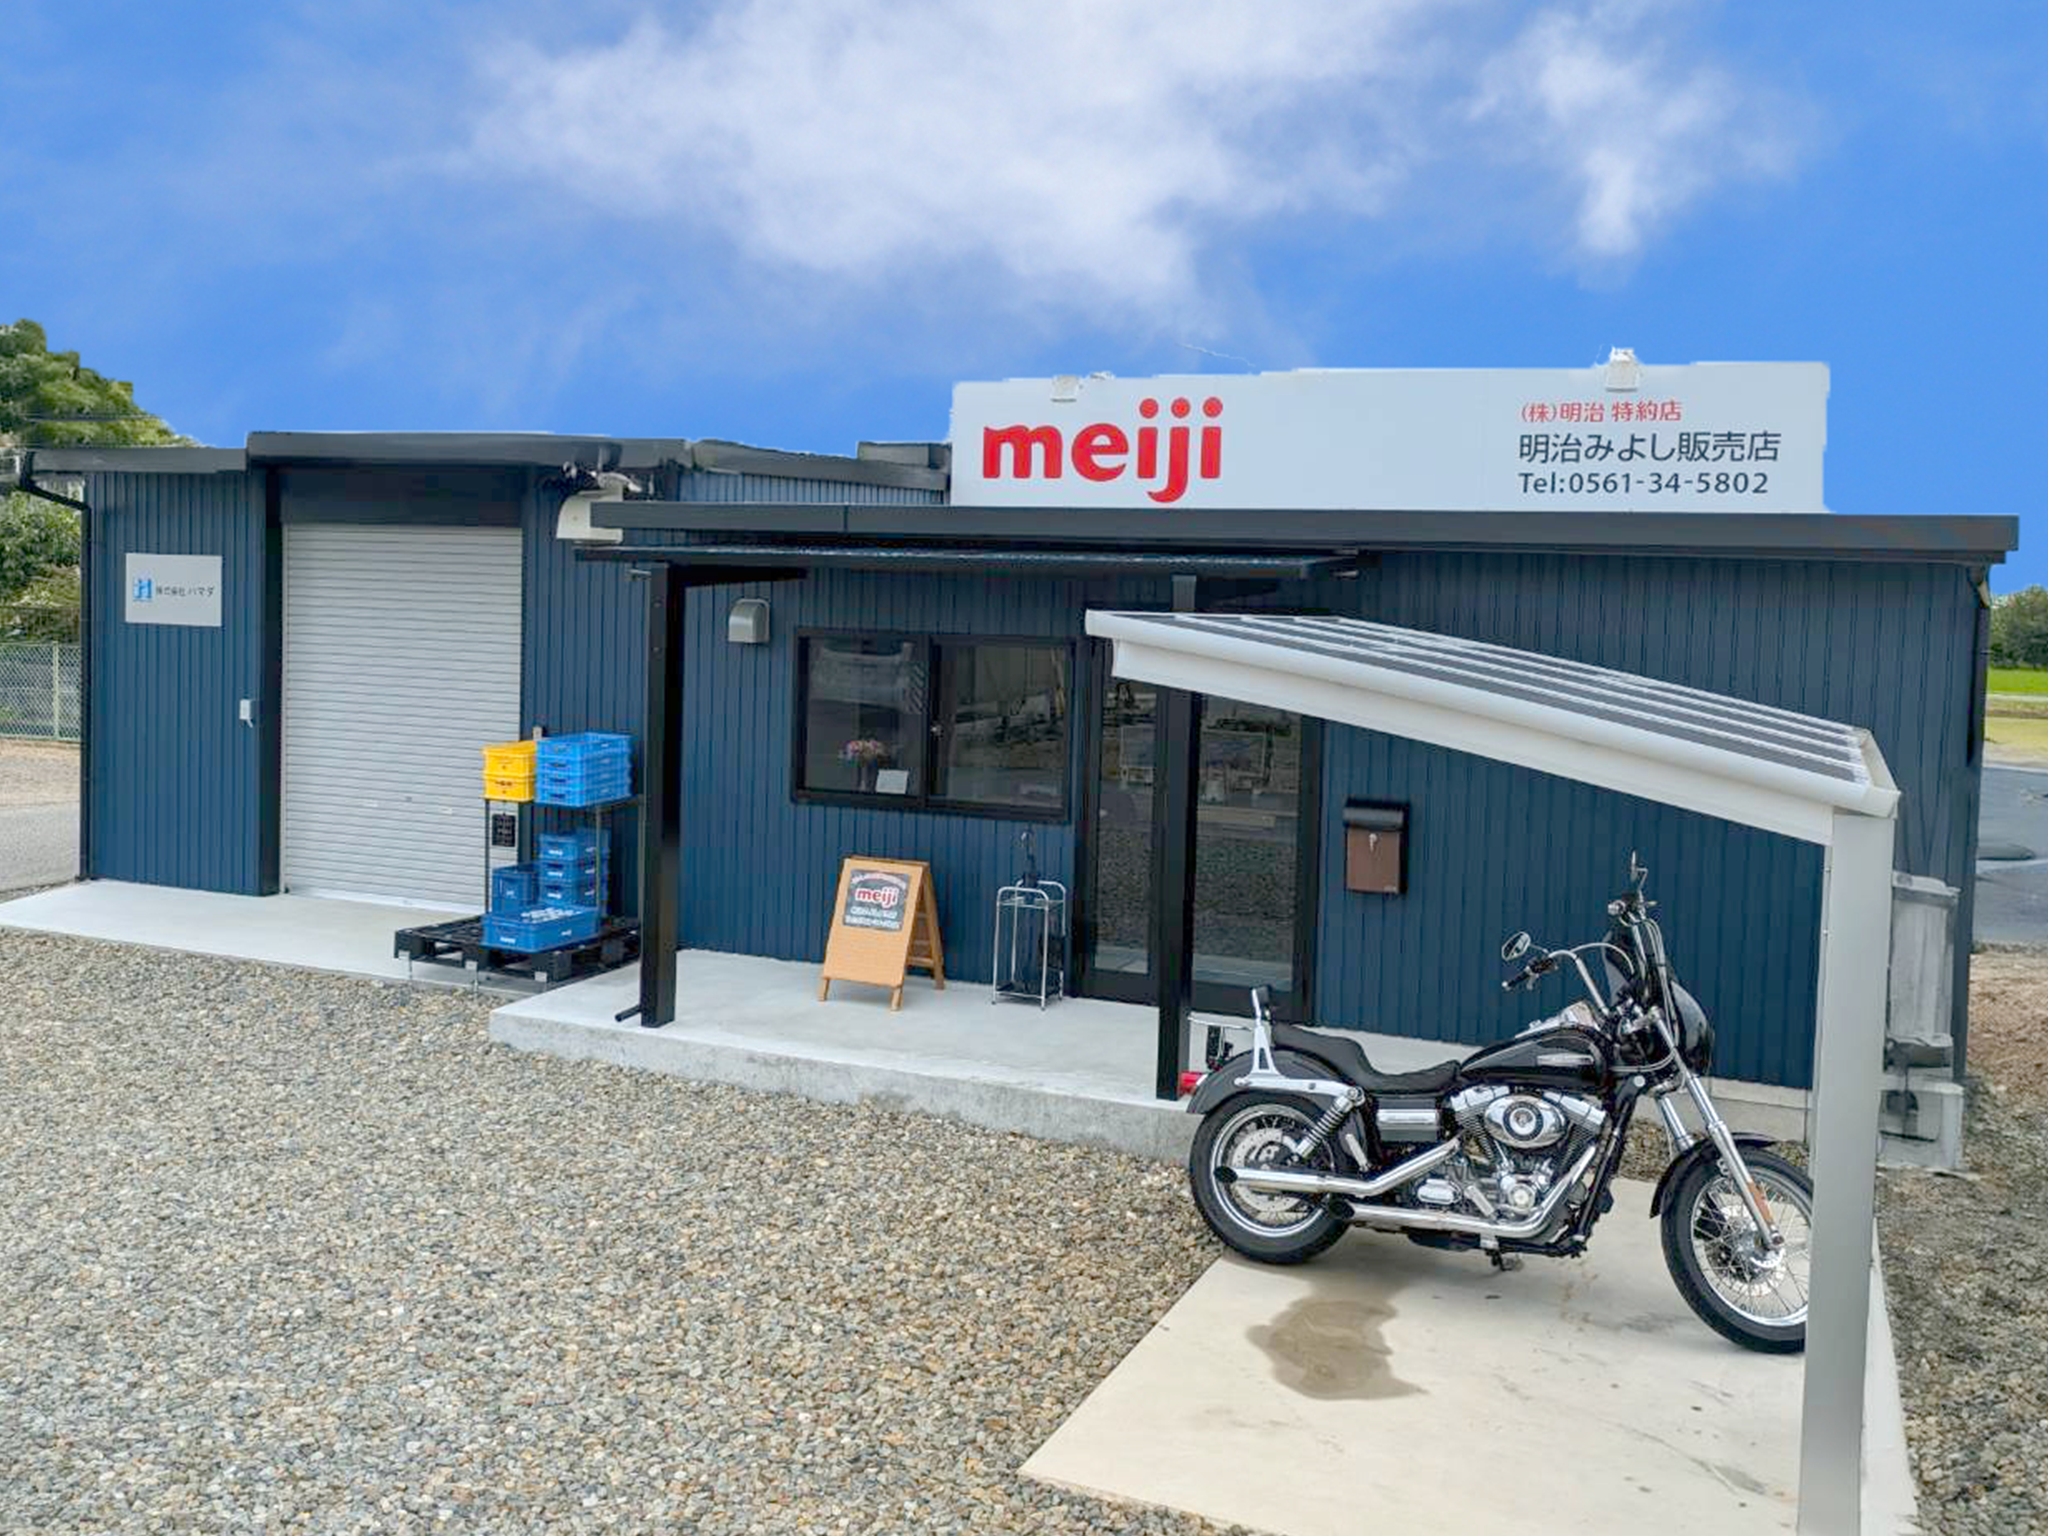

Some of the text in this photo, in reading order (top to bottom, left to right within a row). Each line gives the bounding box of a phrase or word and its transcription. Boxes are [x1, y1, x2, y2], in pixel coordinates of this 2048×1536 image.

[1521, 401, 1682, 422] (株)明治 特約店
[982, 396, 1224, 503] meiji
[1519, 431, 1782, 464] 明治みよし販売店
[1519, 472, 1768, 494] Tel:0561-34-5802
[856, 887, 898, 908] meiji
